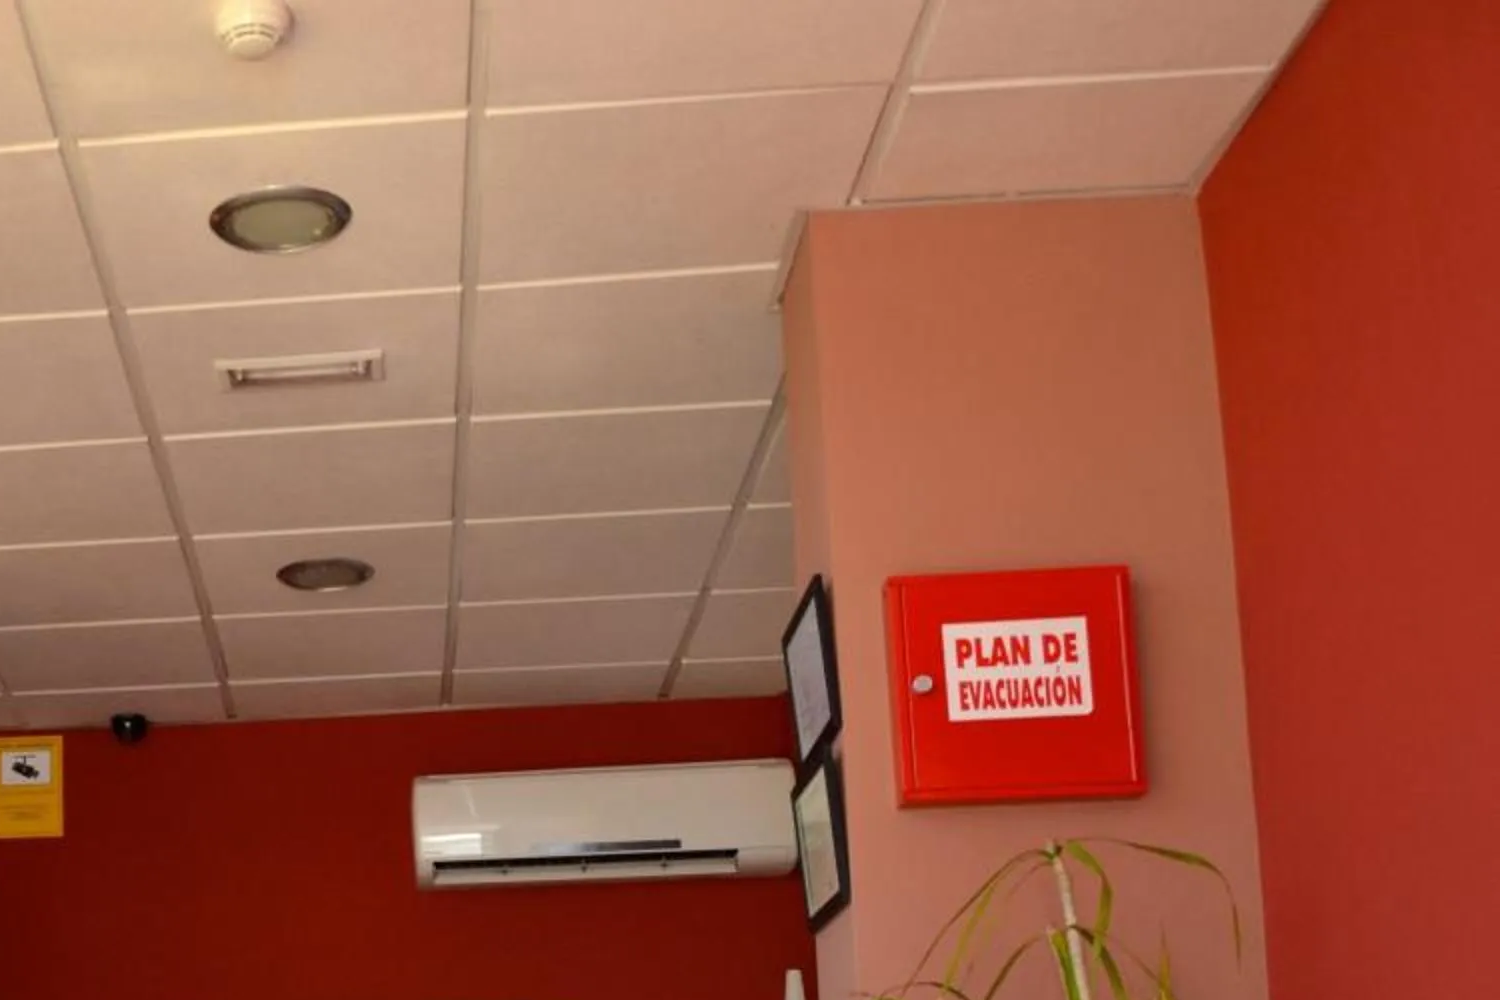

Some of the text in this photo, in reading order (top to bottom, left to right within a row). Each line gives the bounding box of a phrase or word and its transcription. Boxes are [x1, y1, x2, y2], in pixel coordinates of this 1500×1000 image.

[955, 632, 1078, 668] PLAN DE
[959, 665, 1083, 711] EVACUACIÓN
